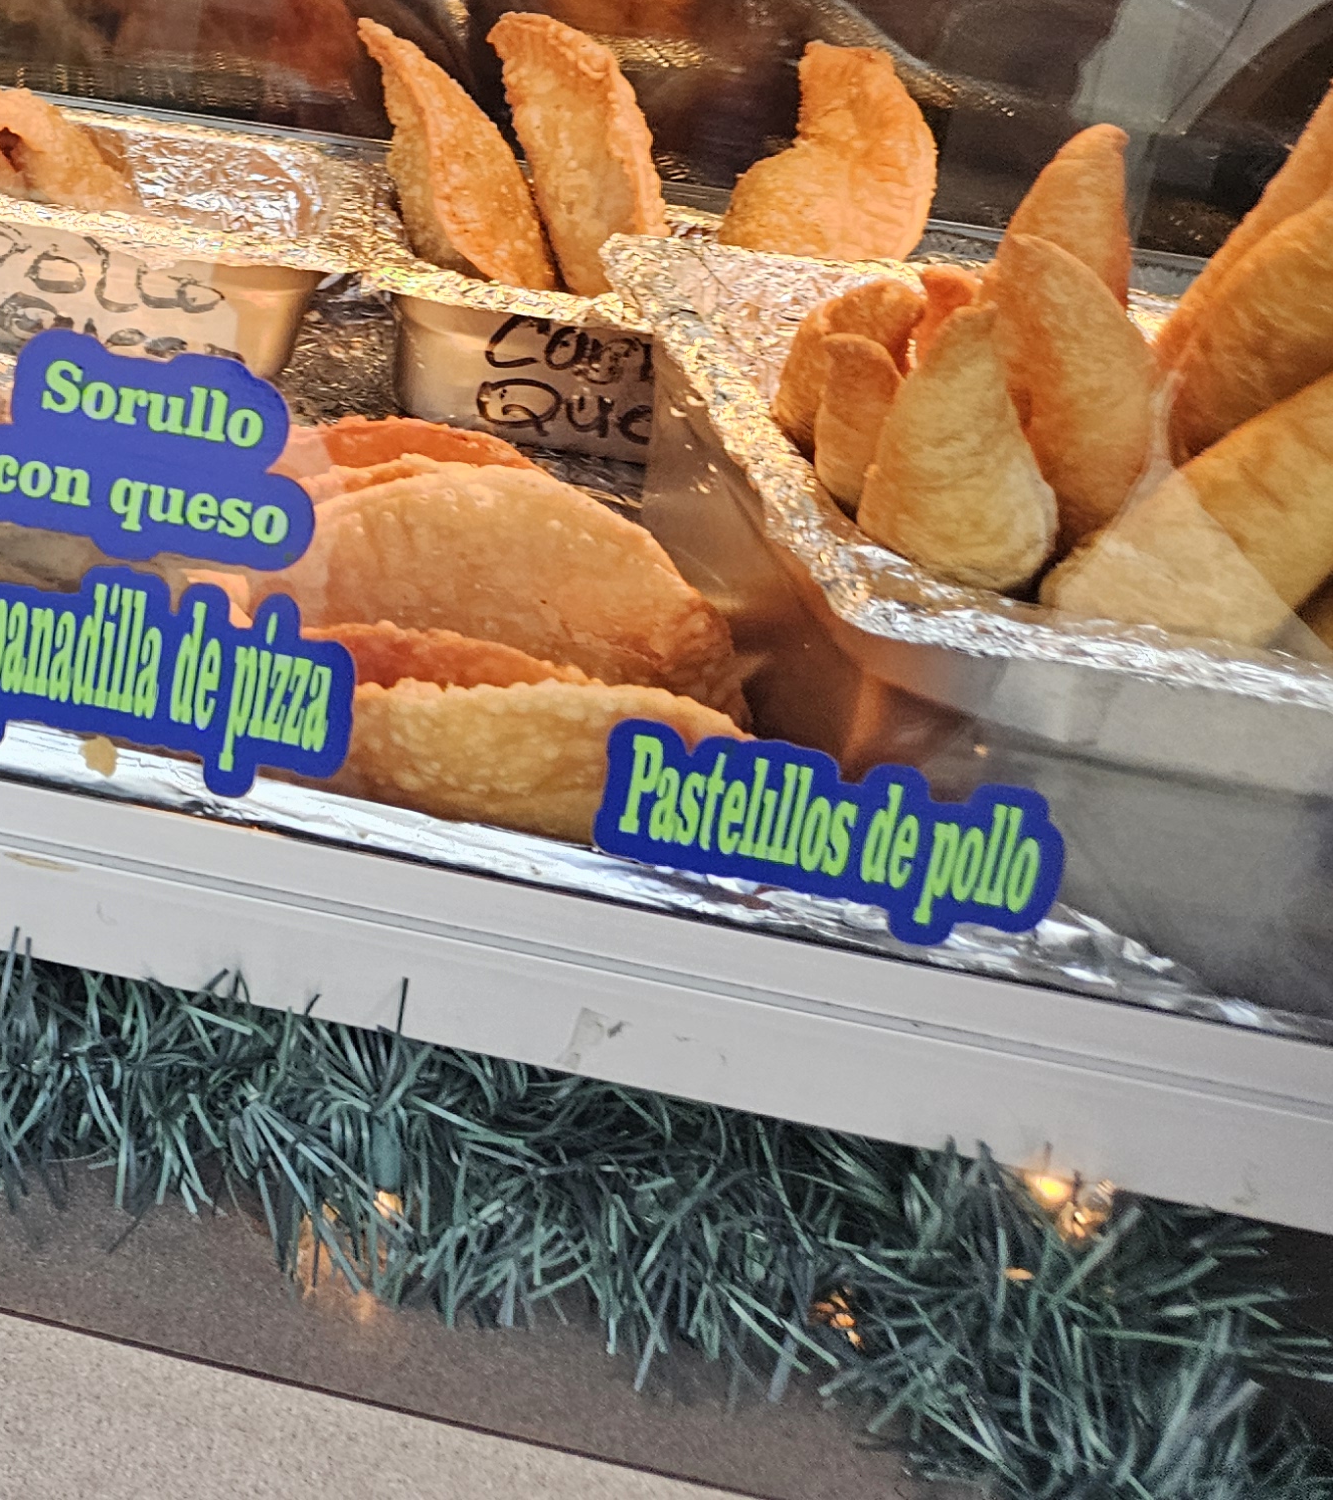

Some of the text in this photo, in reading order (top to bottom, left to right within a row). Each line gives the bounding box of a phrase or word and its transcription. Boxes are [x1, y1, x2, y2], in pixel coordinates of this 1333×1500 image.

[41, 360, 264, 448] Sorullo
[110, 474, 290, 545] queso
[169, 601, 223, 730] de
[218, 612, 332, 772] pizza
[860, 783, 920, 889] de
[912, 803, 1040, 925] pollo
